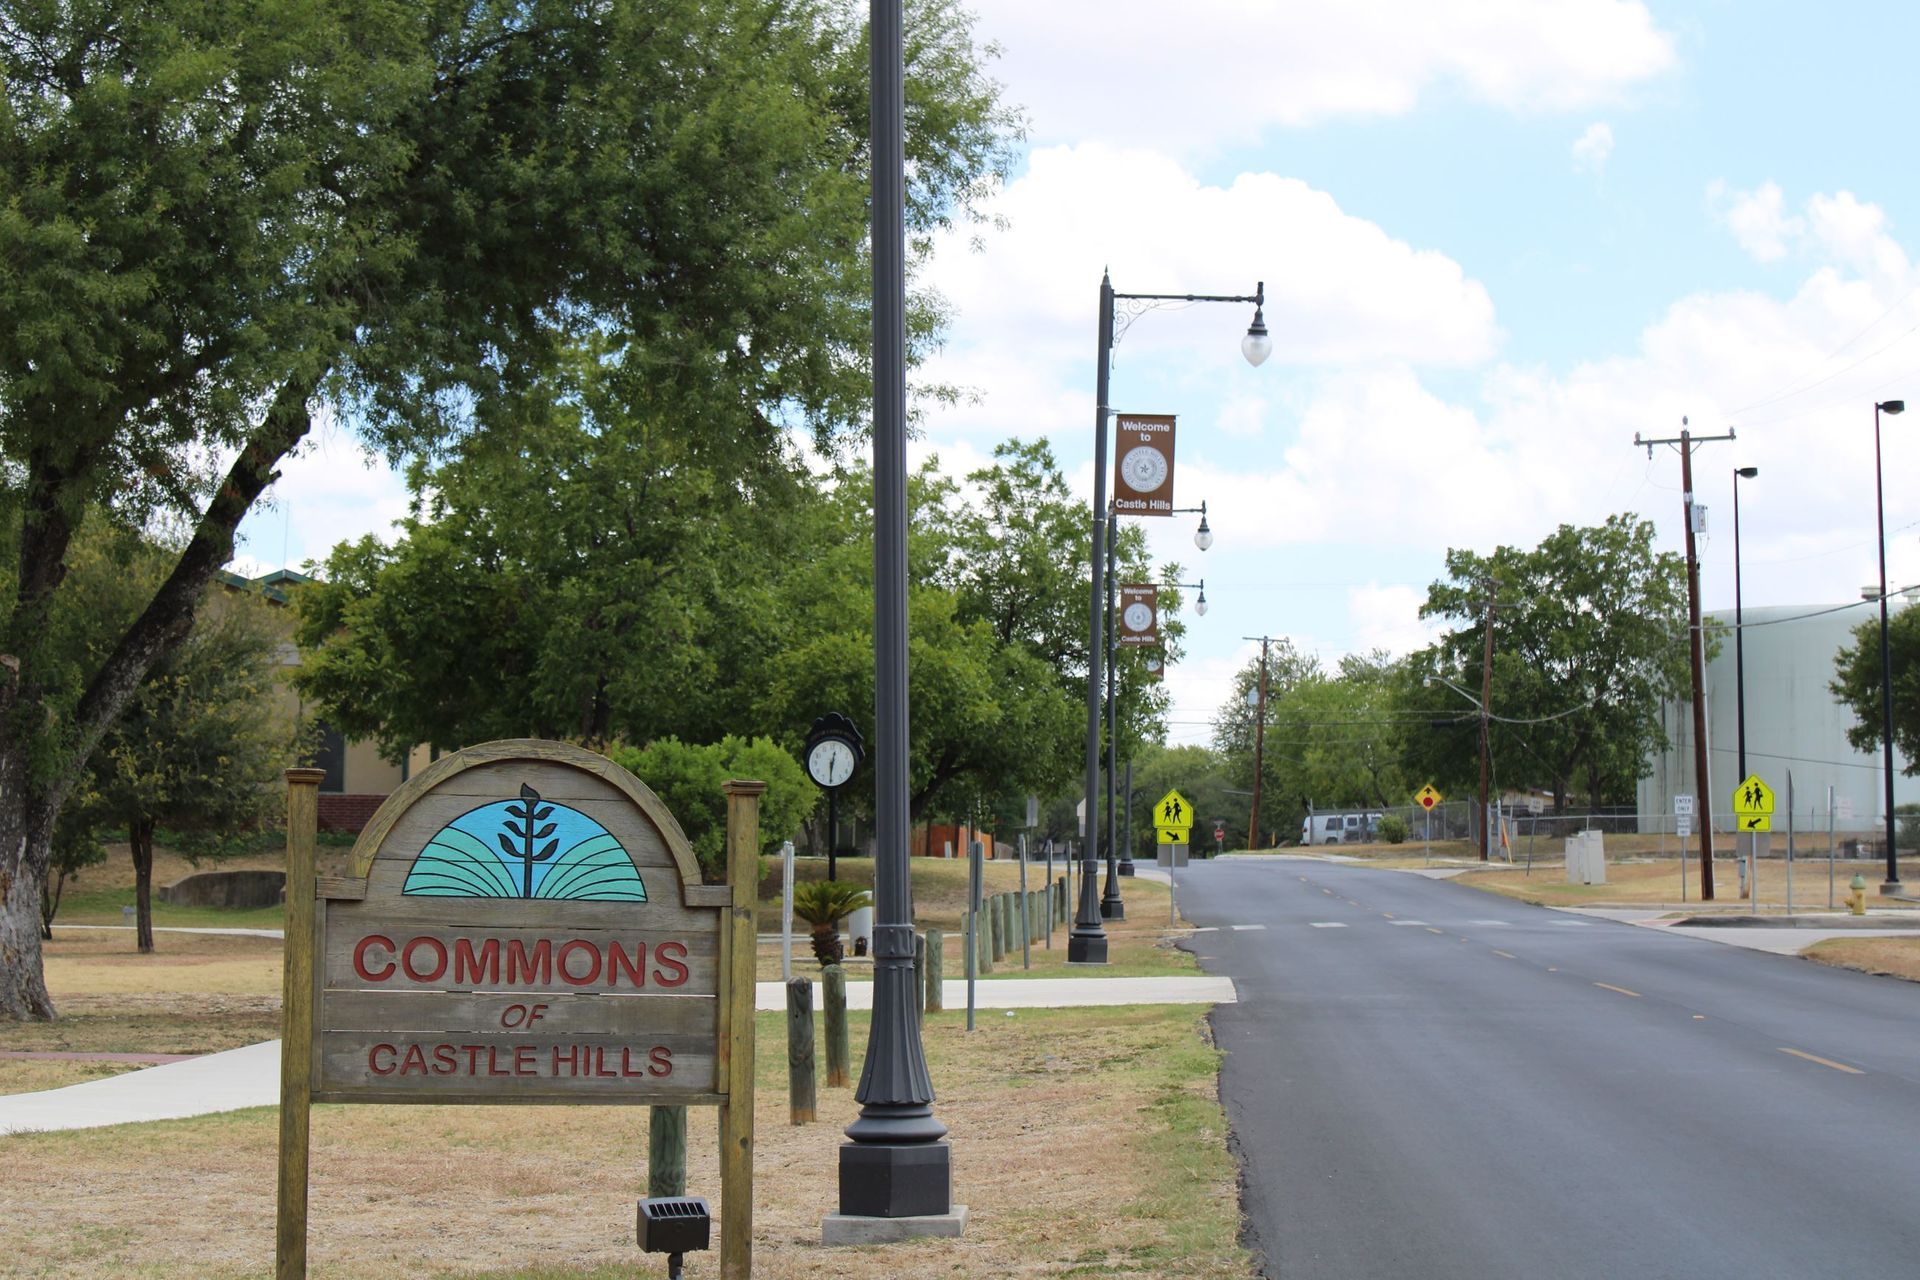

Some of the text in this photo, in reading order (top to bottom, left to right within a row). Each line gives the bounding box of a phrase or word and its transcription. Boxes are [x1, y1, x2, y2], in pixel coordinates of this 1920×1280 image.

[1122, 421, 1170, 432] Welcome
[1140, 433, 1151, 442] to
[1115, 499, 1171, 510] Castle Hills
[353, 934, 689, 988] COMMONS
[500, 1004, 549, 1030] OF
[368, 1043, 673, 1078] CASTLE HILLS
